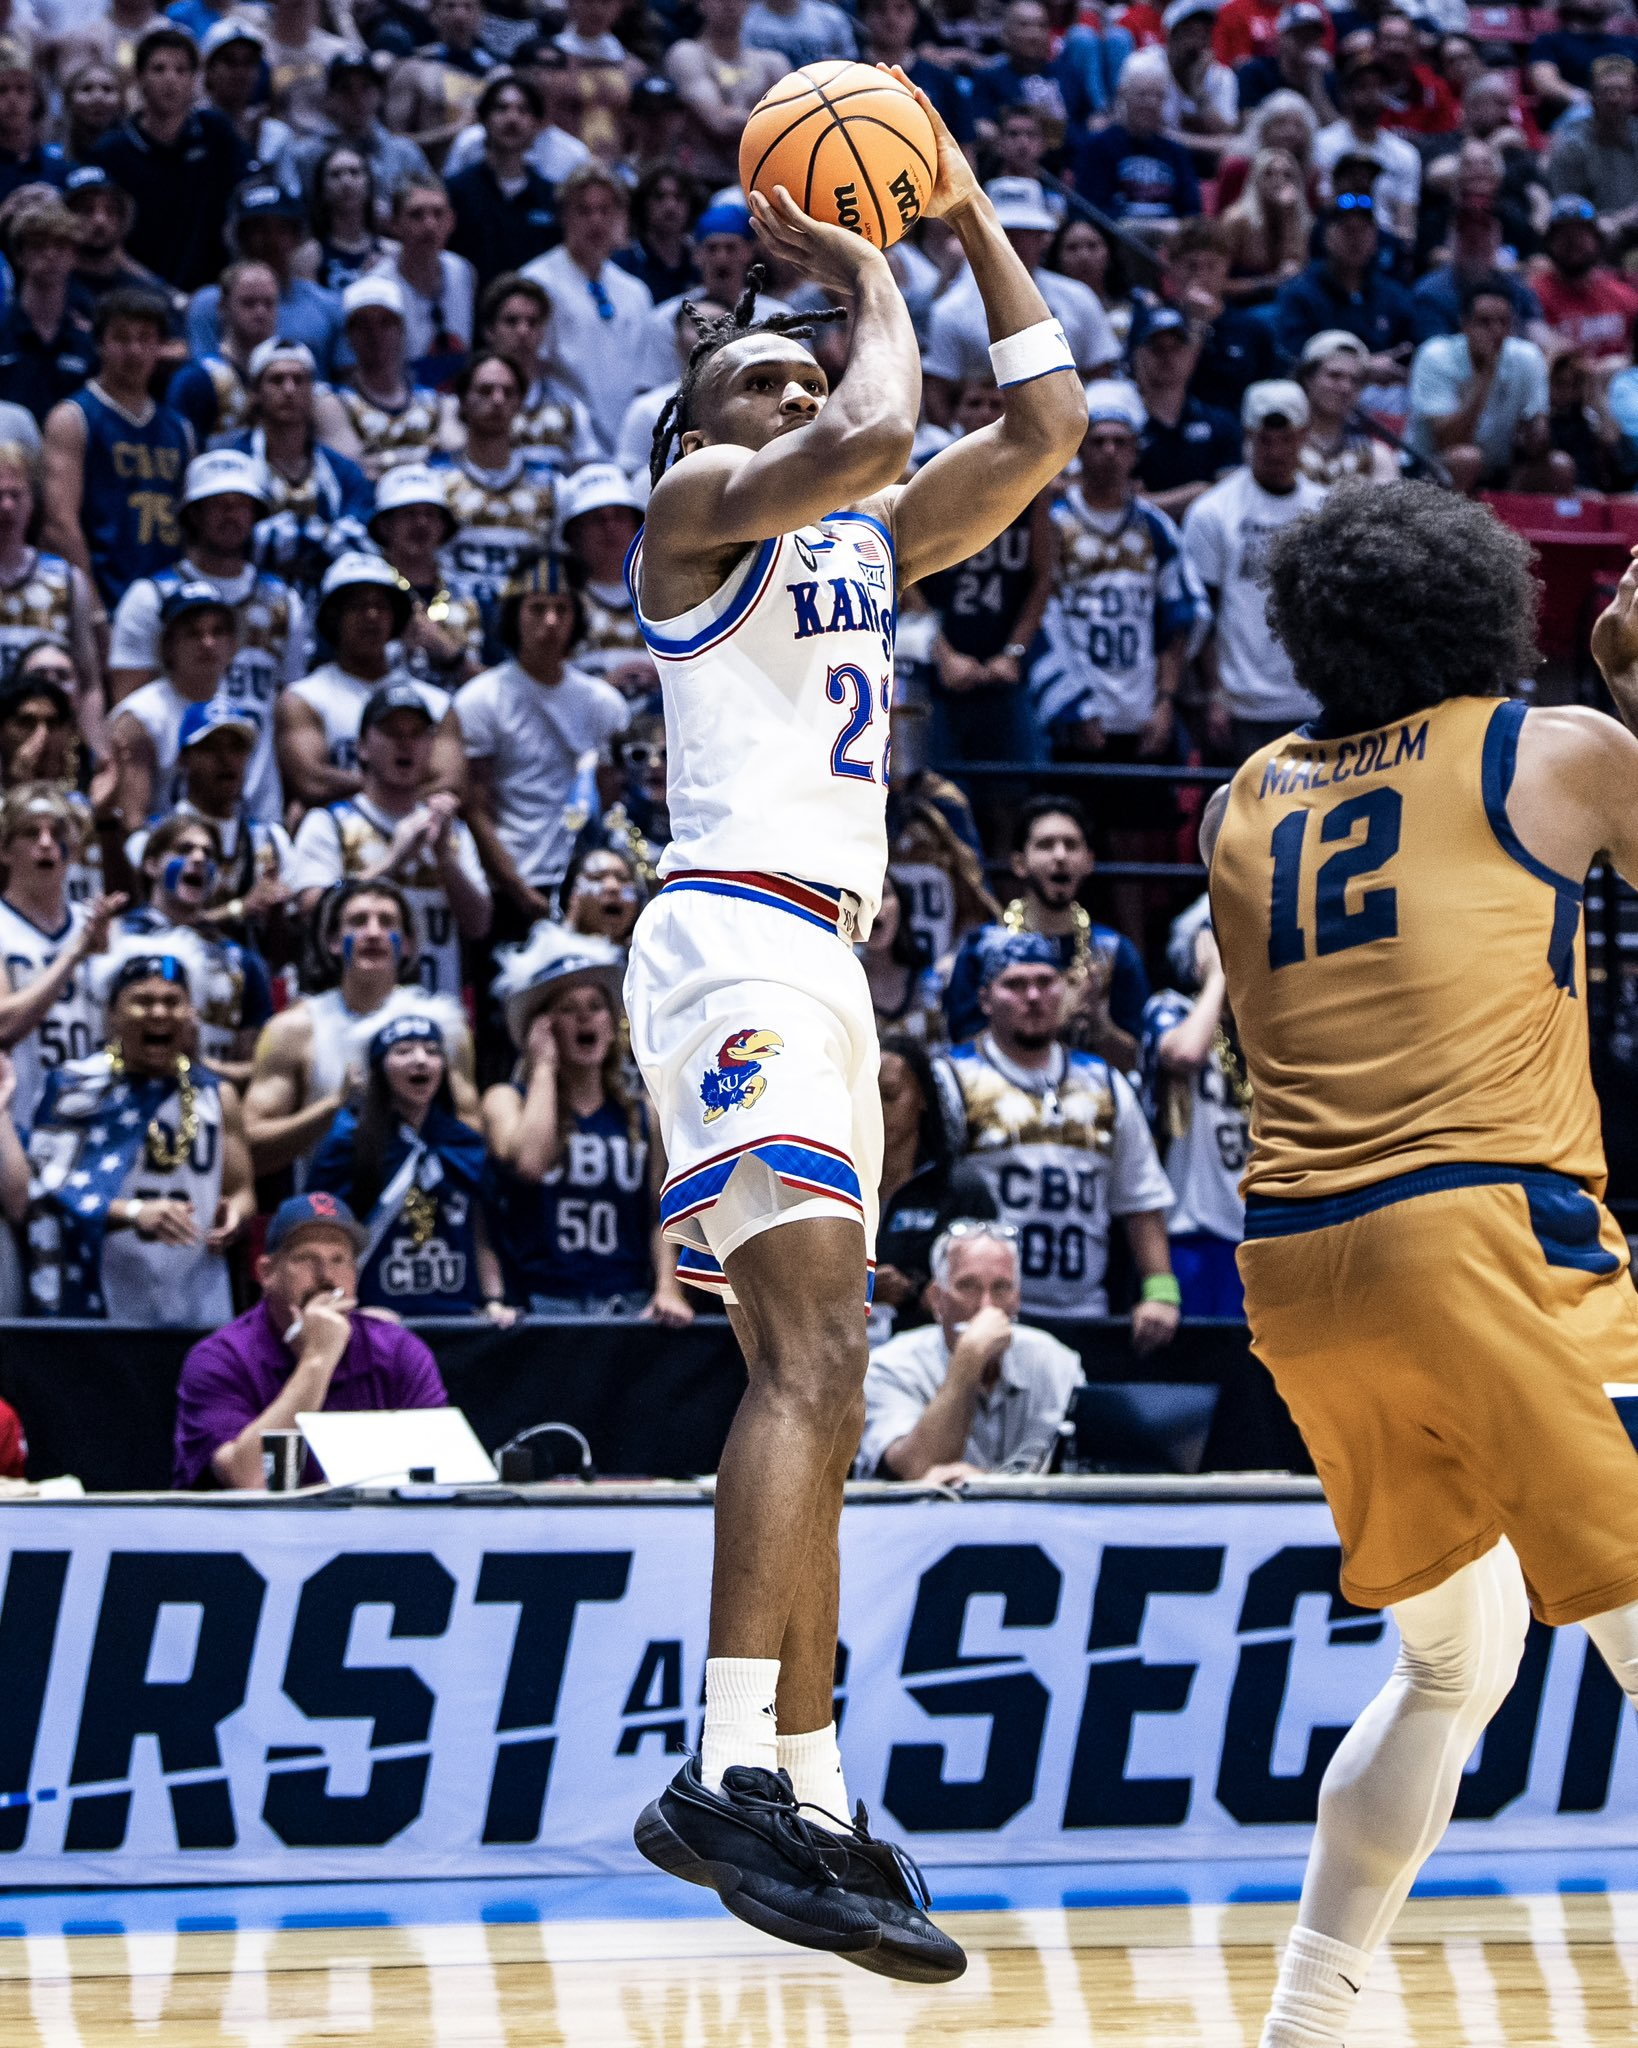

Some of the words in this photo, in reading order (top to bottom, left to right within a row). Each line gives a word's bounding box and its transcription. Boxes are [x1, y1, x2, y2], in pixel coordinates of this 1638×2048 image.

[889, 168, 921, 232] CAA
[1259, 719, 1430, 800] MALCOLM
[1267, 785, 1404, 973] 12
[718, 1074, 740, 1095] KU
[542, 1133, 648, 1193] BU
[1001, 1164, 1099, 1213] CBU
[557, 1198, 618, 1255] 50
[380, 1252, 467, 1296] CBU
[0, 1549, 635, 1854] IRST
